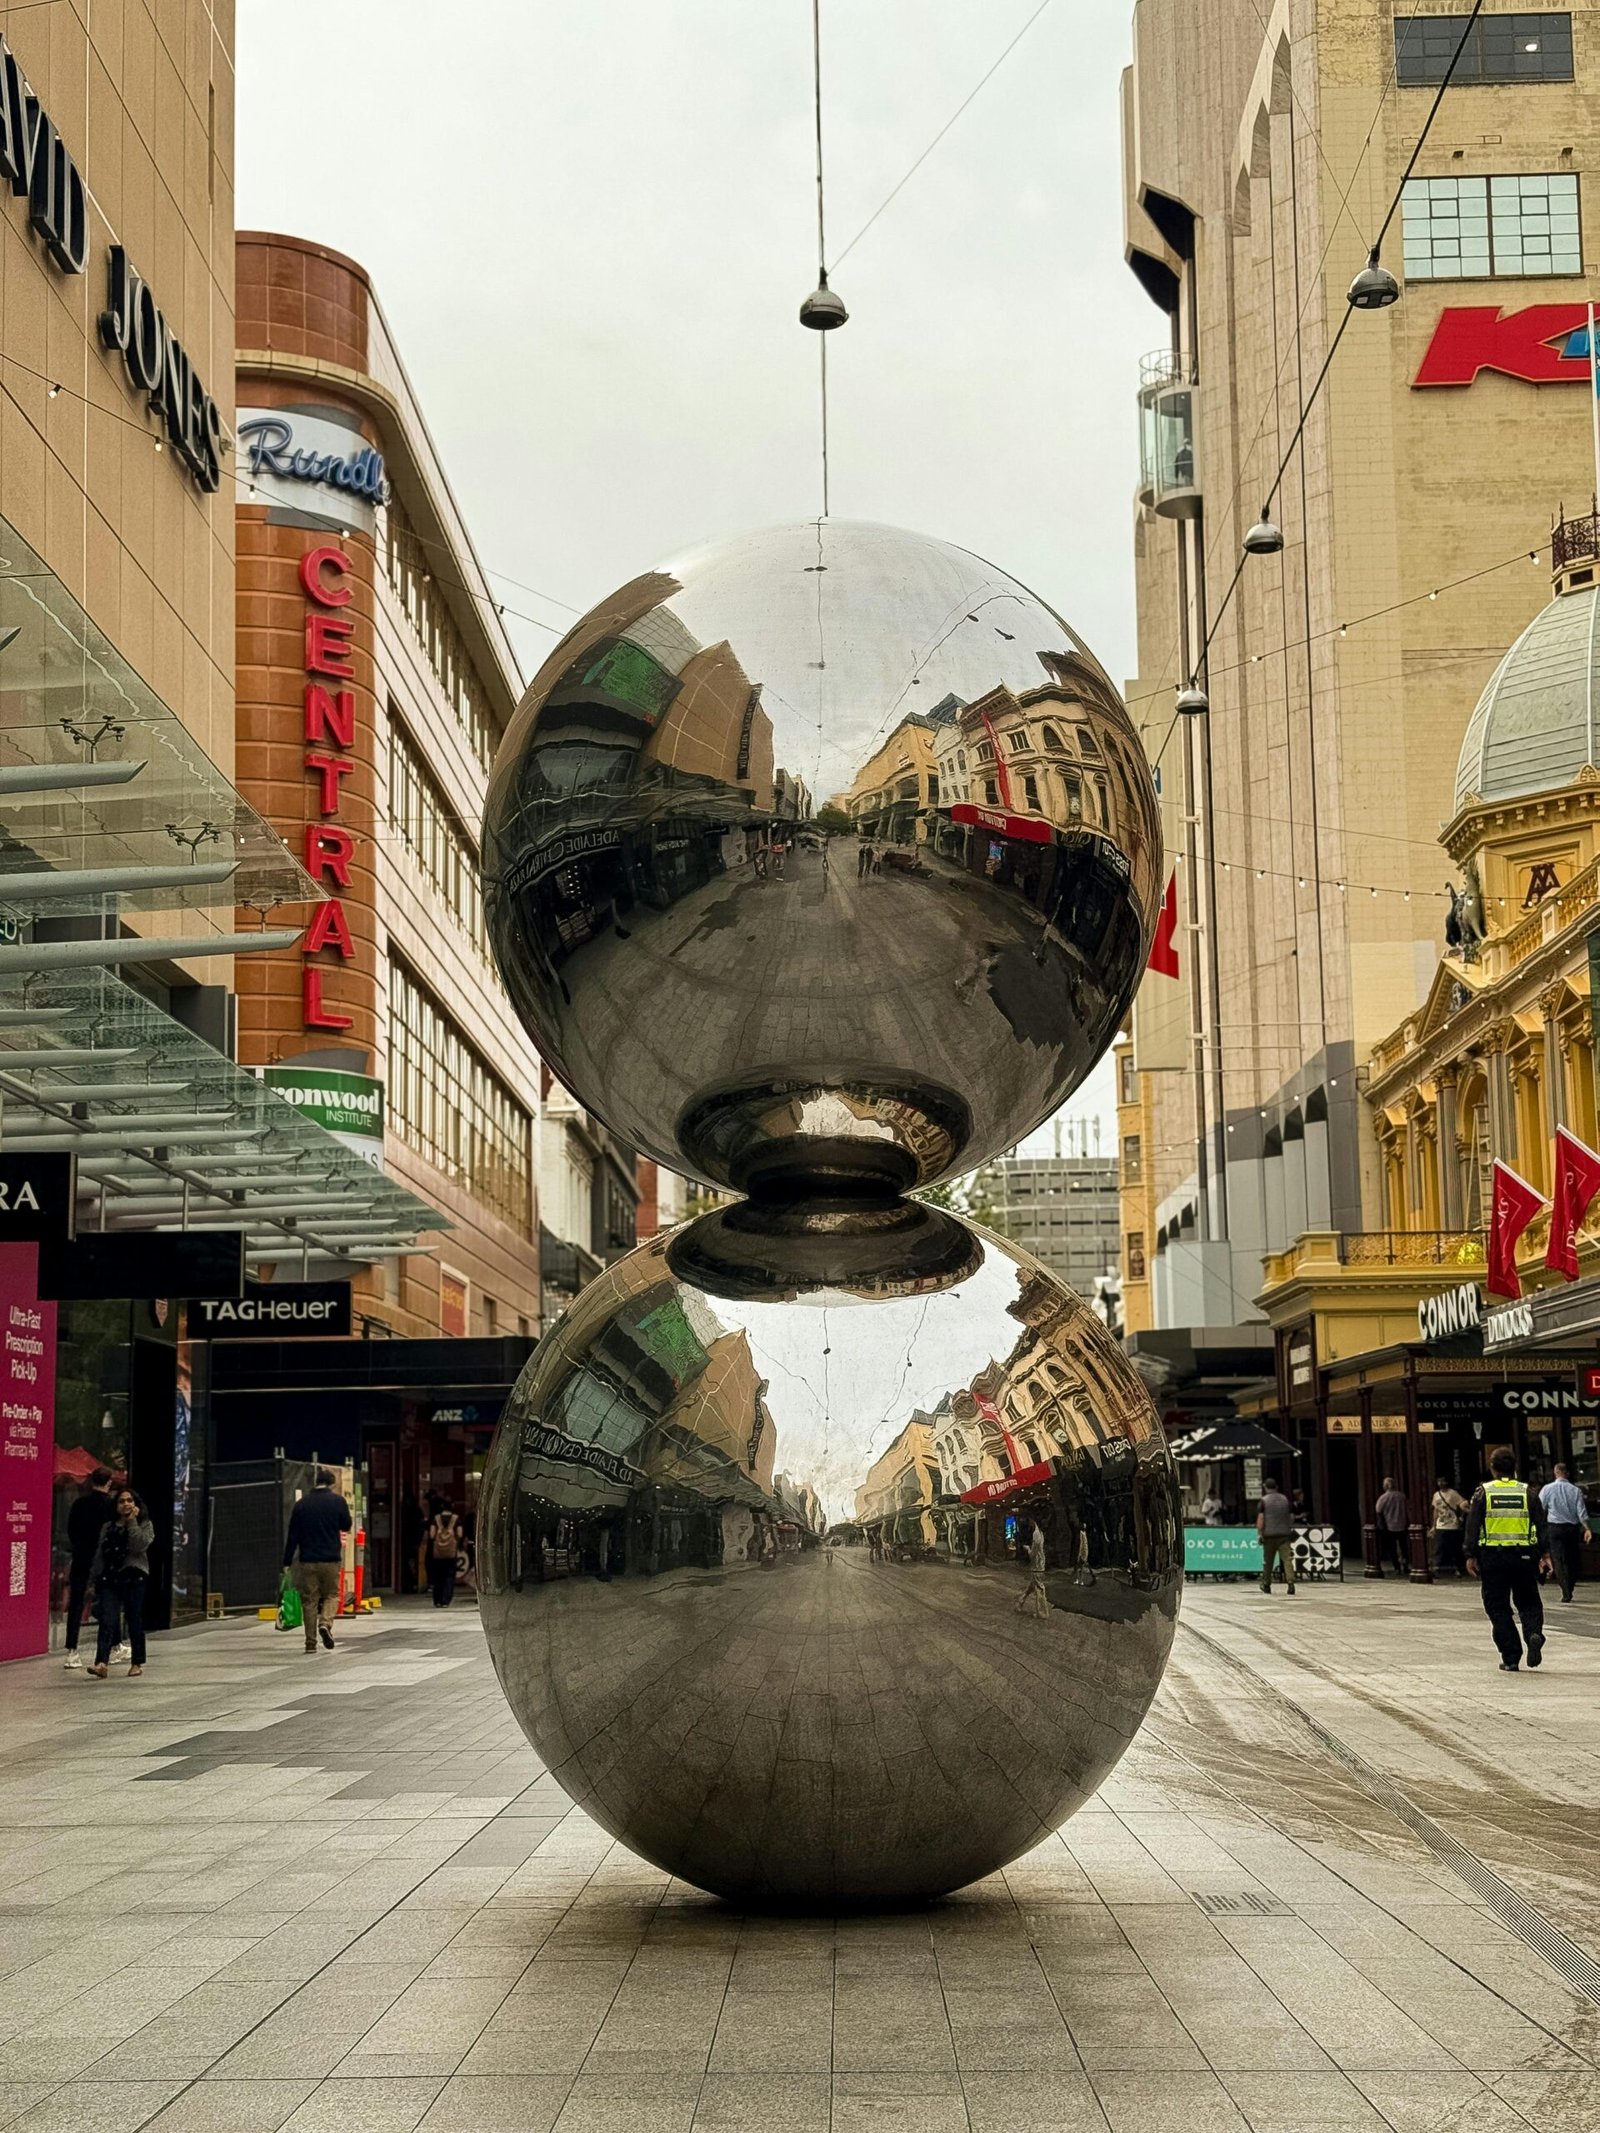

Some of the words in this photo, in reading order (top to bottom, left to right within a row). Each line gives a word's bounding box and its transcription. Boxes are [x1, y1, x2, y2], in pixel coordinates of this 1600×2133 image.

[101, 245, 219, 492] JONES
[300, 546, 355, 1030] CENTRAL
[326, 1110, 372, 1127] INSTITUTE
[1418, 1282, 1480, 1341] CONNOR
[11, 1358, 38, 1385] Pick-Up
[432, 1410, 463, 1421] ANZ
[1453, 1401, 1490, 1409] BLACK
[1186, 1539, 1215, 1549] OKO
[1222, 1539, 1261, 1549] BLAC
